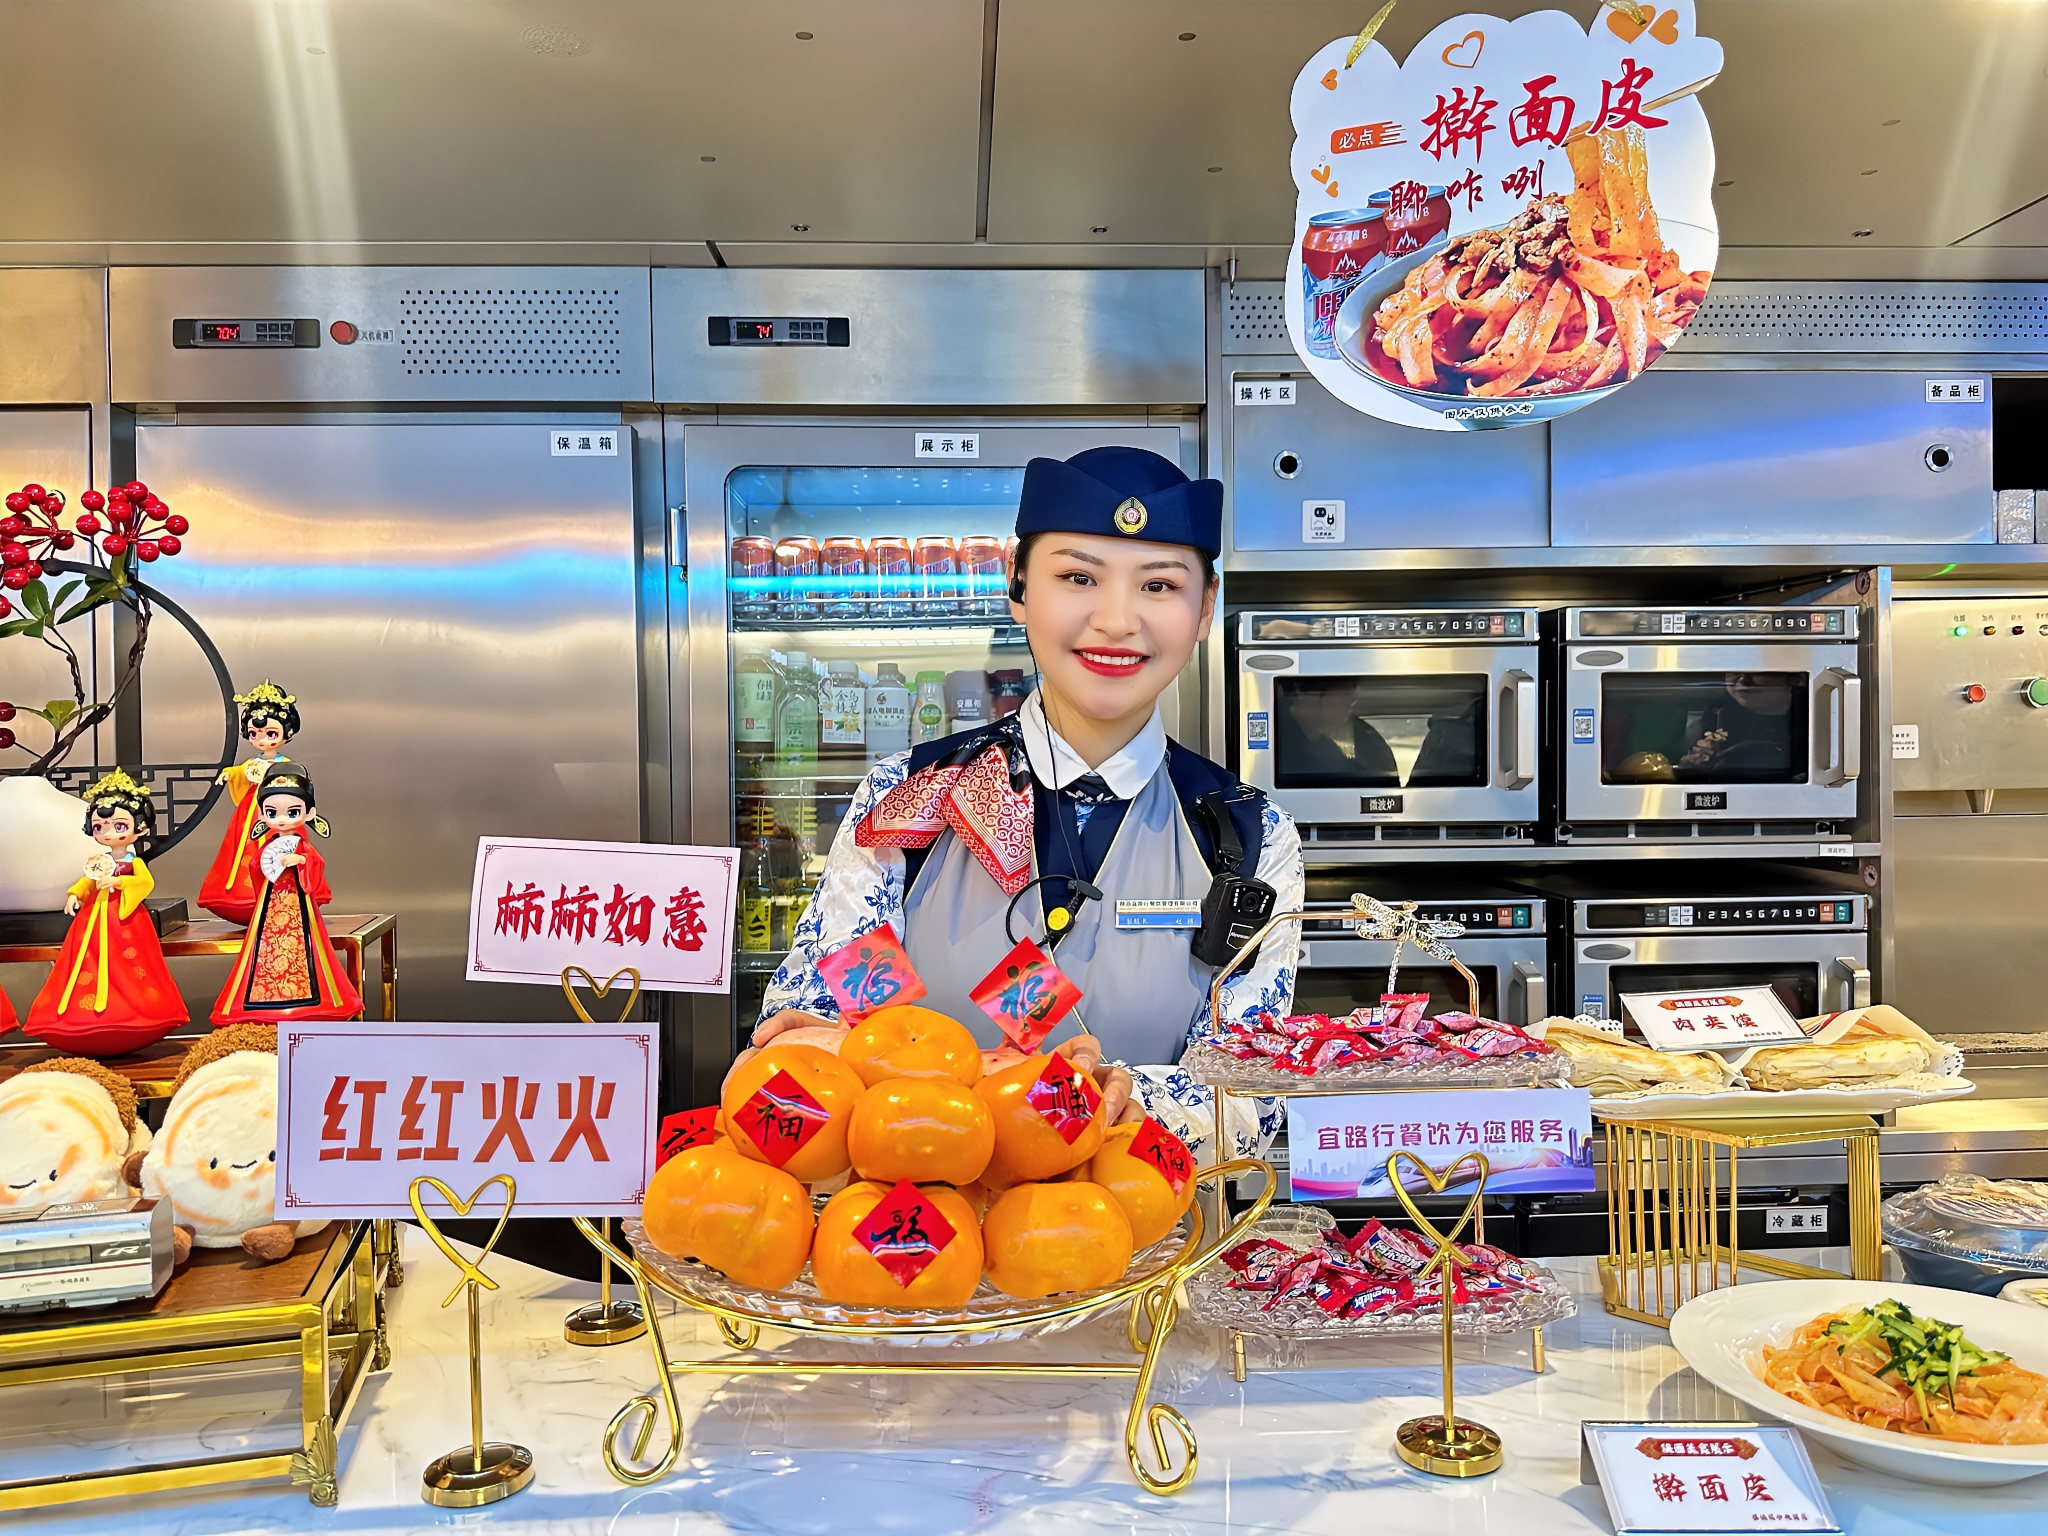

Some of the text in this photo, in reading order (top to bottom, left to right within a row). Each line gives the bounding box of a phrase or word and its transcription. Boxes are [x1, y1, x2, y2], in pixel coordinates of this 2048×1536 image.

[1420, 58, 1669, 162] 擀面皮
[1338, 128, 1374, 149] 必点
[1388, 159, 1544, 221] 聊咋咧
[1239, 385, 1291, 401] 操作区
[1931, 383, 1981, 401] 备品柜
[1445, 403, 1533, 420] 图片仅供参考
[556, 436, 612, 451] 保温箱
[920, 438, 975, 453] 展示柜
[1369, 798, 1395, 812] 微波炉
[1693, 795, 1720, 808] 微波炉
[494, 880, 707, 952] 柿柿如意
[842, 947, 902, 1010] 福
[999, 958, 1057, 1022] 福
[1672, 1013, 1758, 1031] 肉夹馍
[1051, 1075, 1087, 1120] 福
[319, 1075, 616, 1162] 红红火火
[755, 1096, 805, 1144] 福
[1317, 1119, 1563, 1151] 宜路行餐饮为您服务
[1772, 1212, 1823, 1228] 冷藏柜
[1652, 1472, 1774, 1502] 擀面皮
